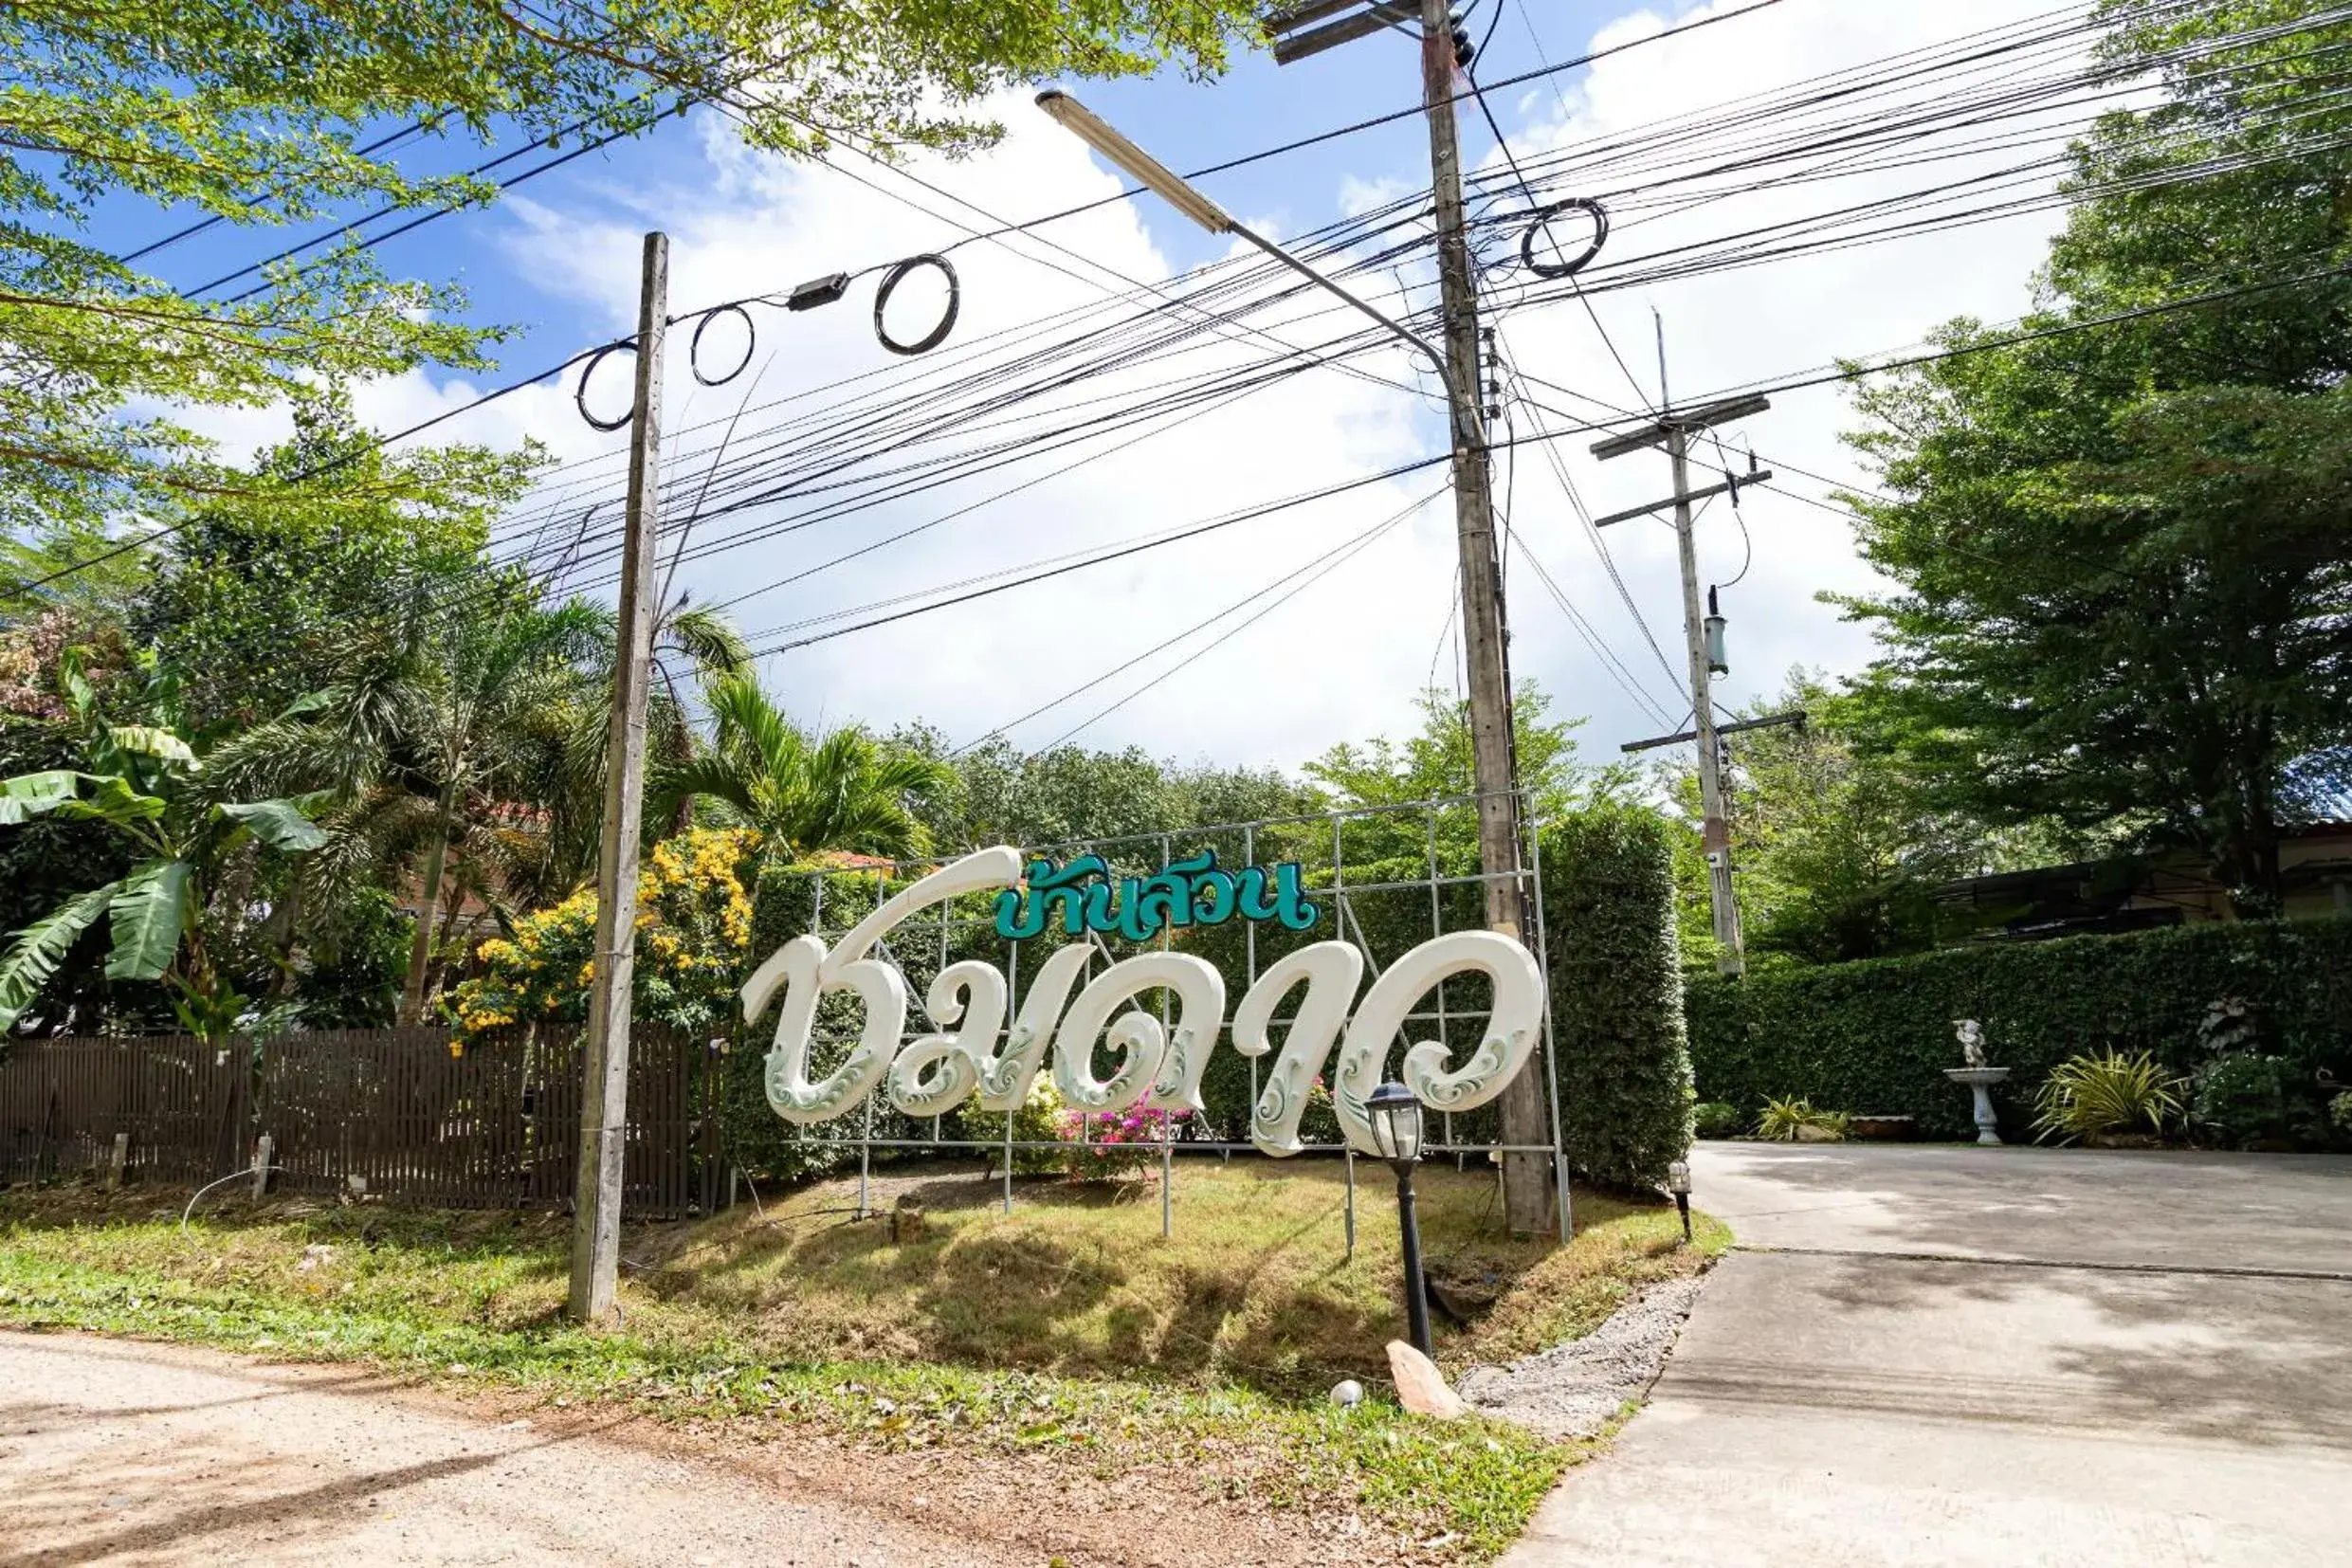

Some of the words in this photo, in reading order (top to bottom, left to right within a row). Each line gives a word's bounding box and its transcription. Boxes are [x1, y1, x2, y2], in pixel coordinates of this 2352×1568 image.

[994, 848, 1321, 941] บ้านสวน
[740, 845, 1544, 1158] ชมดาว
